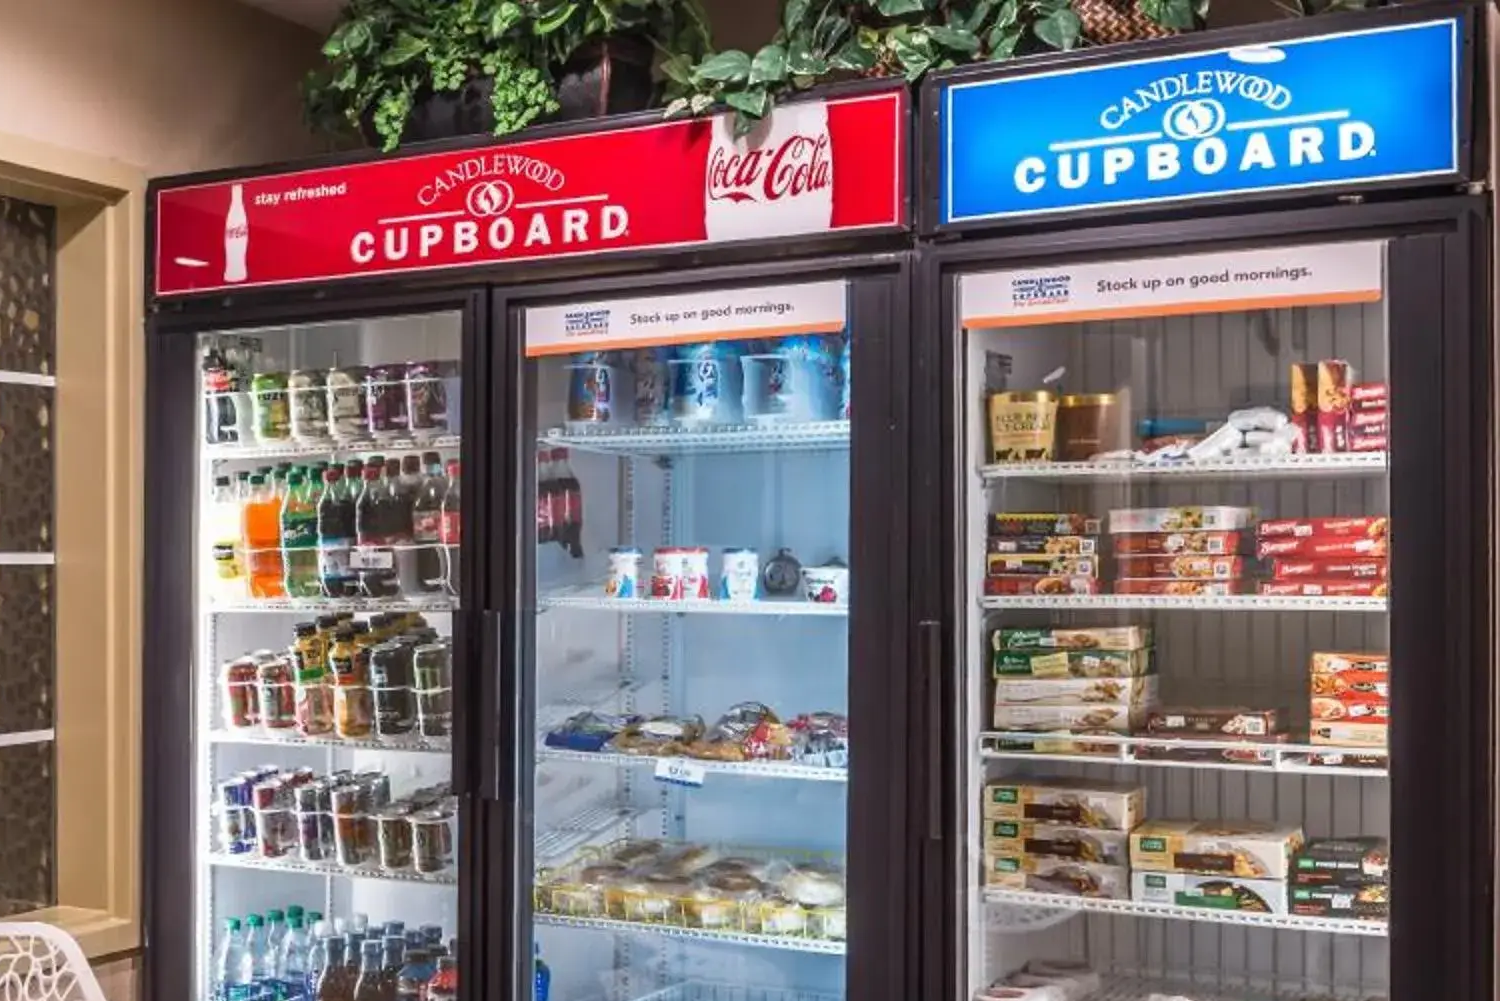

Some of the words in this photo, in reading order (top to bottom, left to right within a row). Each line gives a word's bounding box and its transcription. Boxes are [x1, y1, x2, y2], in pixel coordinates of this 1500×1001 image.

[1099, 70, 1292, 130] CANDLEWOOD
[417, 153, 565, 206] CANDLEWOOD
[708, 133, 830, 203] Coca-Cola
[1013, 121, 1376, 194] CUPBOARD
[255, 192, 281, 205] stay
[284, 182, 347, 201] refreshed
[351, 205, 629, 263] CUPBOARD
[1096, 279, 1138, 293] Stock
[1143, 279, 1162, 292] up
[1166, 277, 1185, 288] on
[1189, 270, 1230, 288] good
[1233, 265, 1313, 283] mornings.
[630, 311, 662, 325] Stock
[665, 312, 681, 323] up
[683, 310, 697, 320] on
[701, 306, 732, 320] good
[735, 302, 795, 316] mornings.
